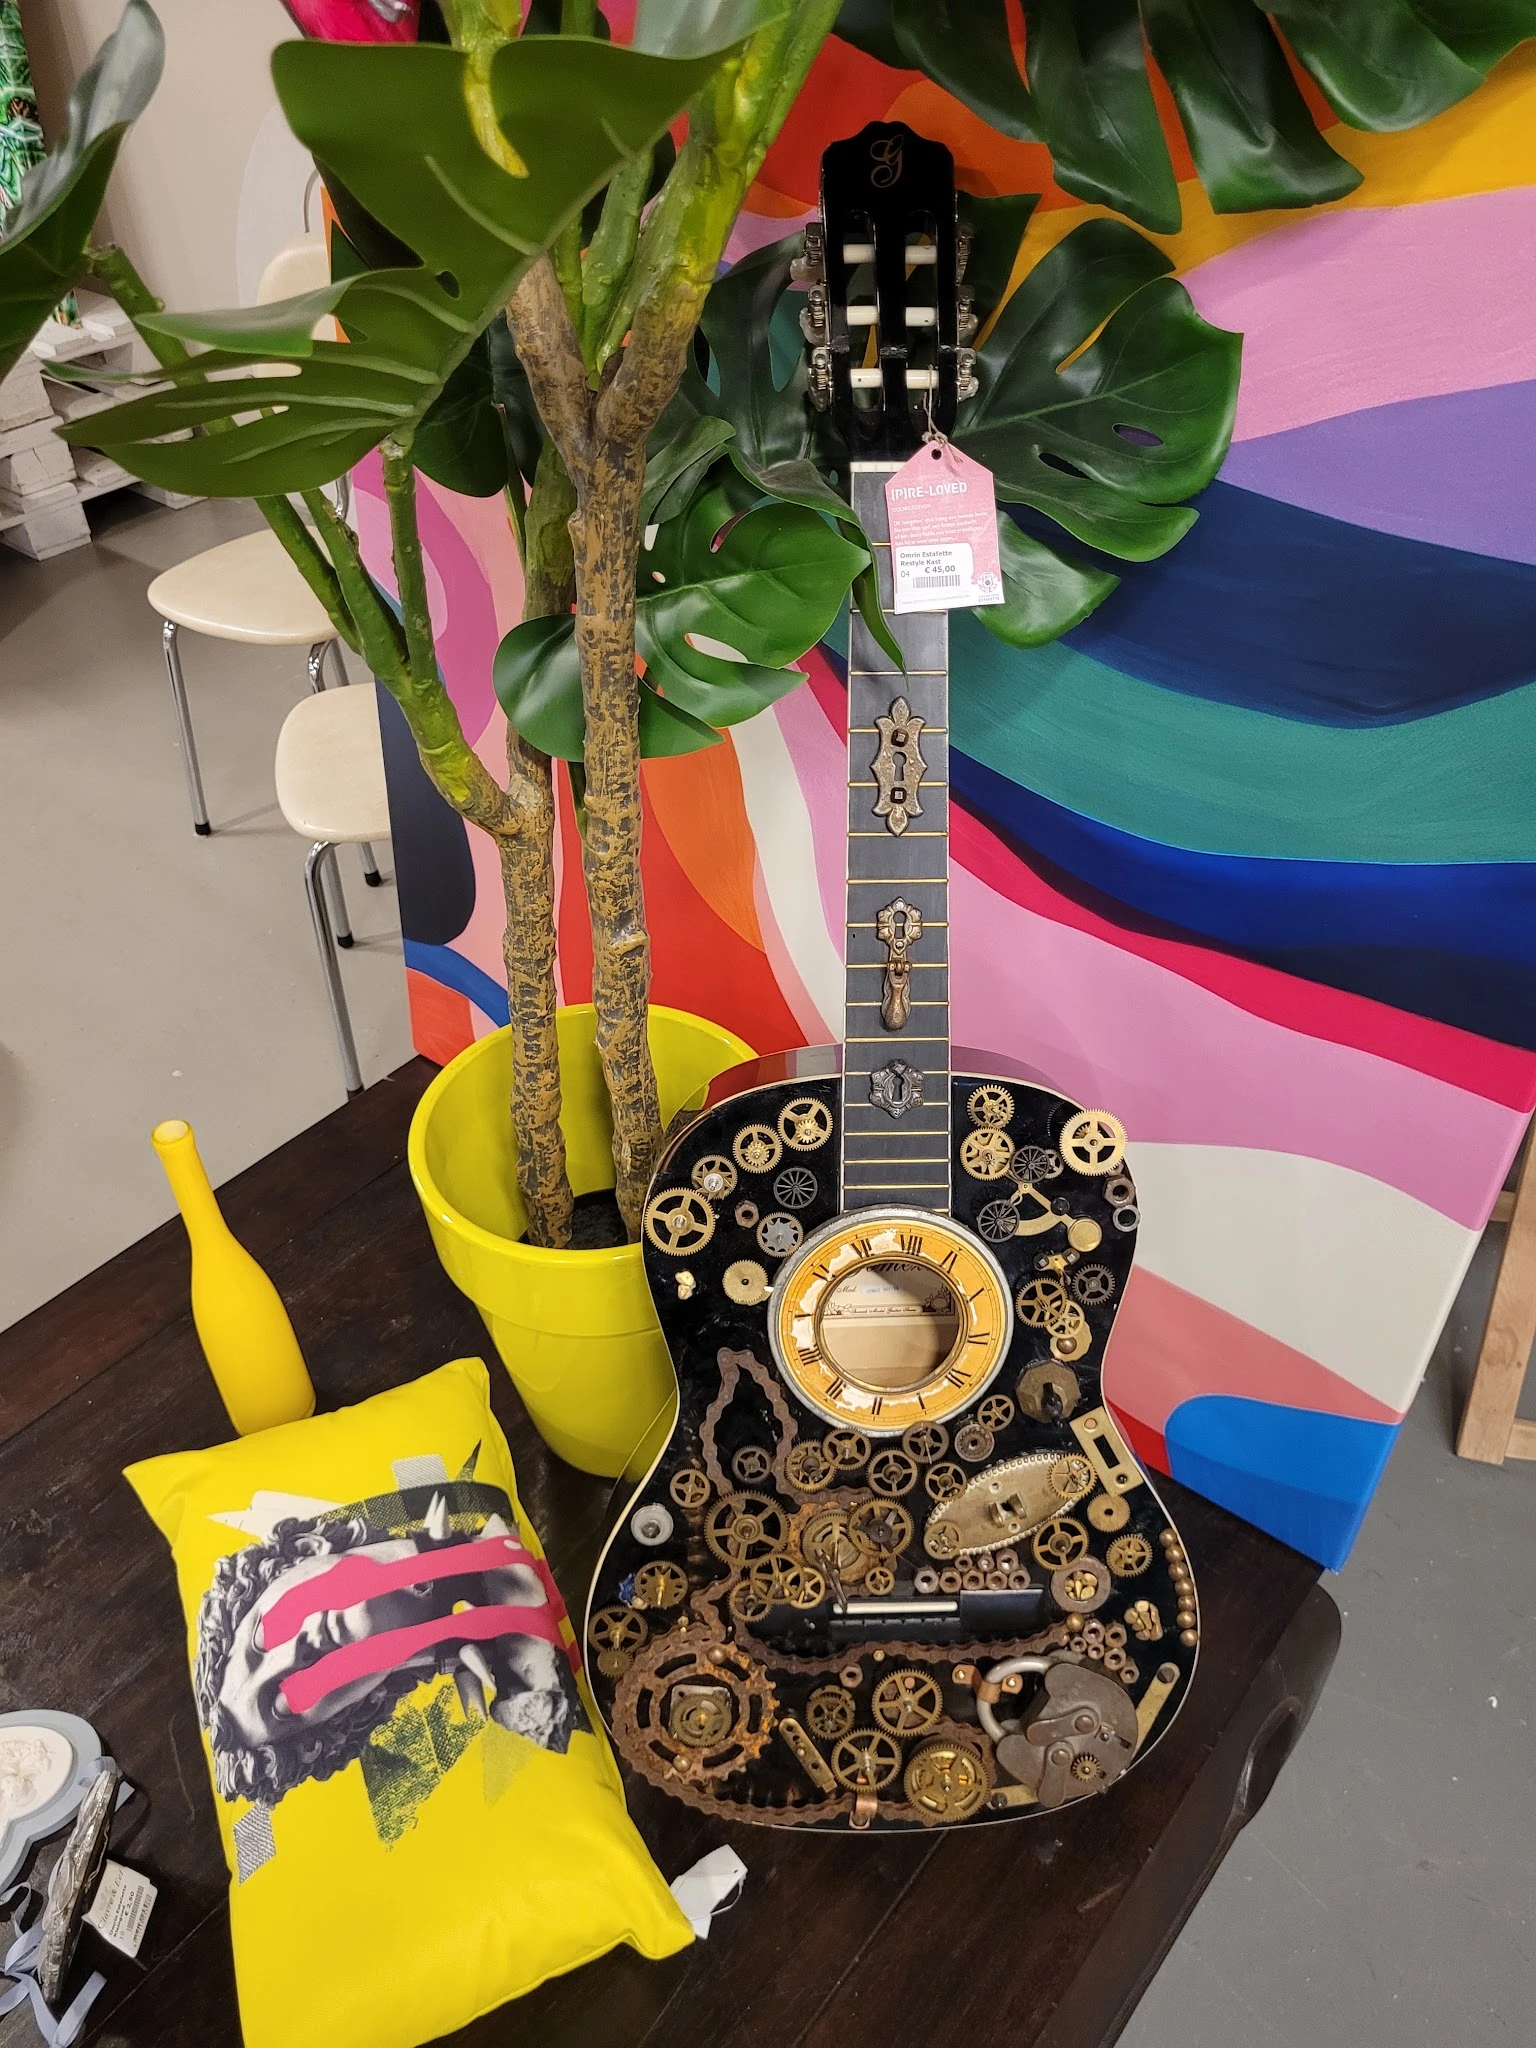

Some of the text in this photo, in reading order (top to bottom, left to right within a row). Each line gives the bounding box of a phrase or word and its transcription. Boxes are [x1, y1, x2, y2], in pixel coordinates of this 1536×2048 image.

[891, 481, 967, 502] (P)RE-LOVED
[922, 550, 953, 558] Estafette
[900, 559, 925, 568] Restyle
[900, 570, 910, 578] 04
[924, 565, 956, 574] € 45,00
[126, 1891, 135, 1909] 2,50
